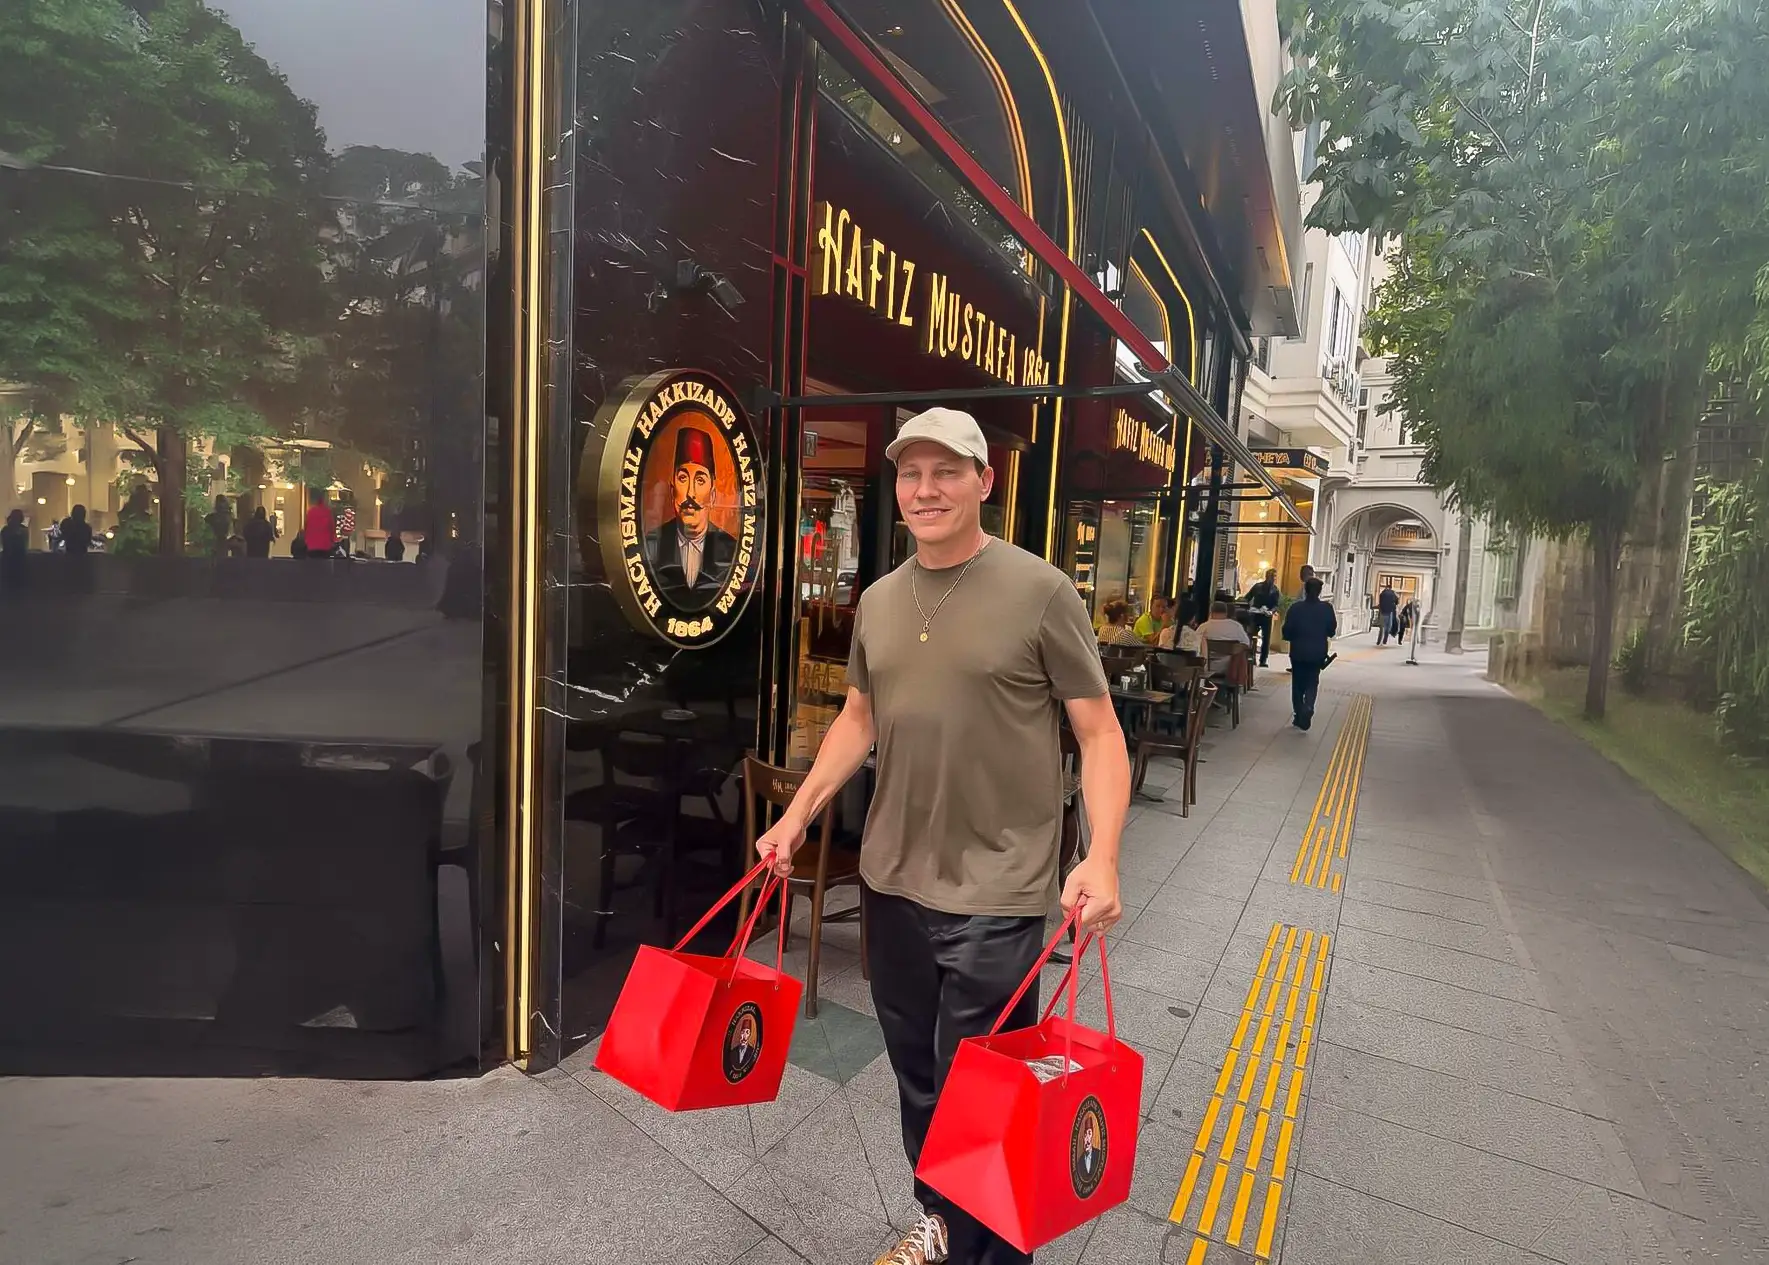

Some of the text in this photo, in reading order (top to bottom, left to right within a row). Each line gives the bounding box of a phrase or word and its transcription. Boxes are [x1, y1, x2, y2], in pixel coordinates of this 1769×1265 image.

[818, 200, 916, 327] HAFIZ
[928, 272, 1016, 386] MUSTAFA
[636, 381, 737, 439] HAKKIZADE
[732, 431, 757, 507] HAFIZ
[626, 552, 663, 618] HACI
[715, 513, 756, 615] MUSTAFA
[666, 615, 714, 638] 1864
